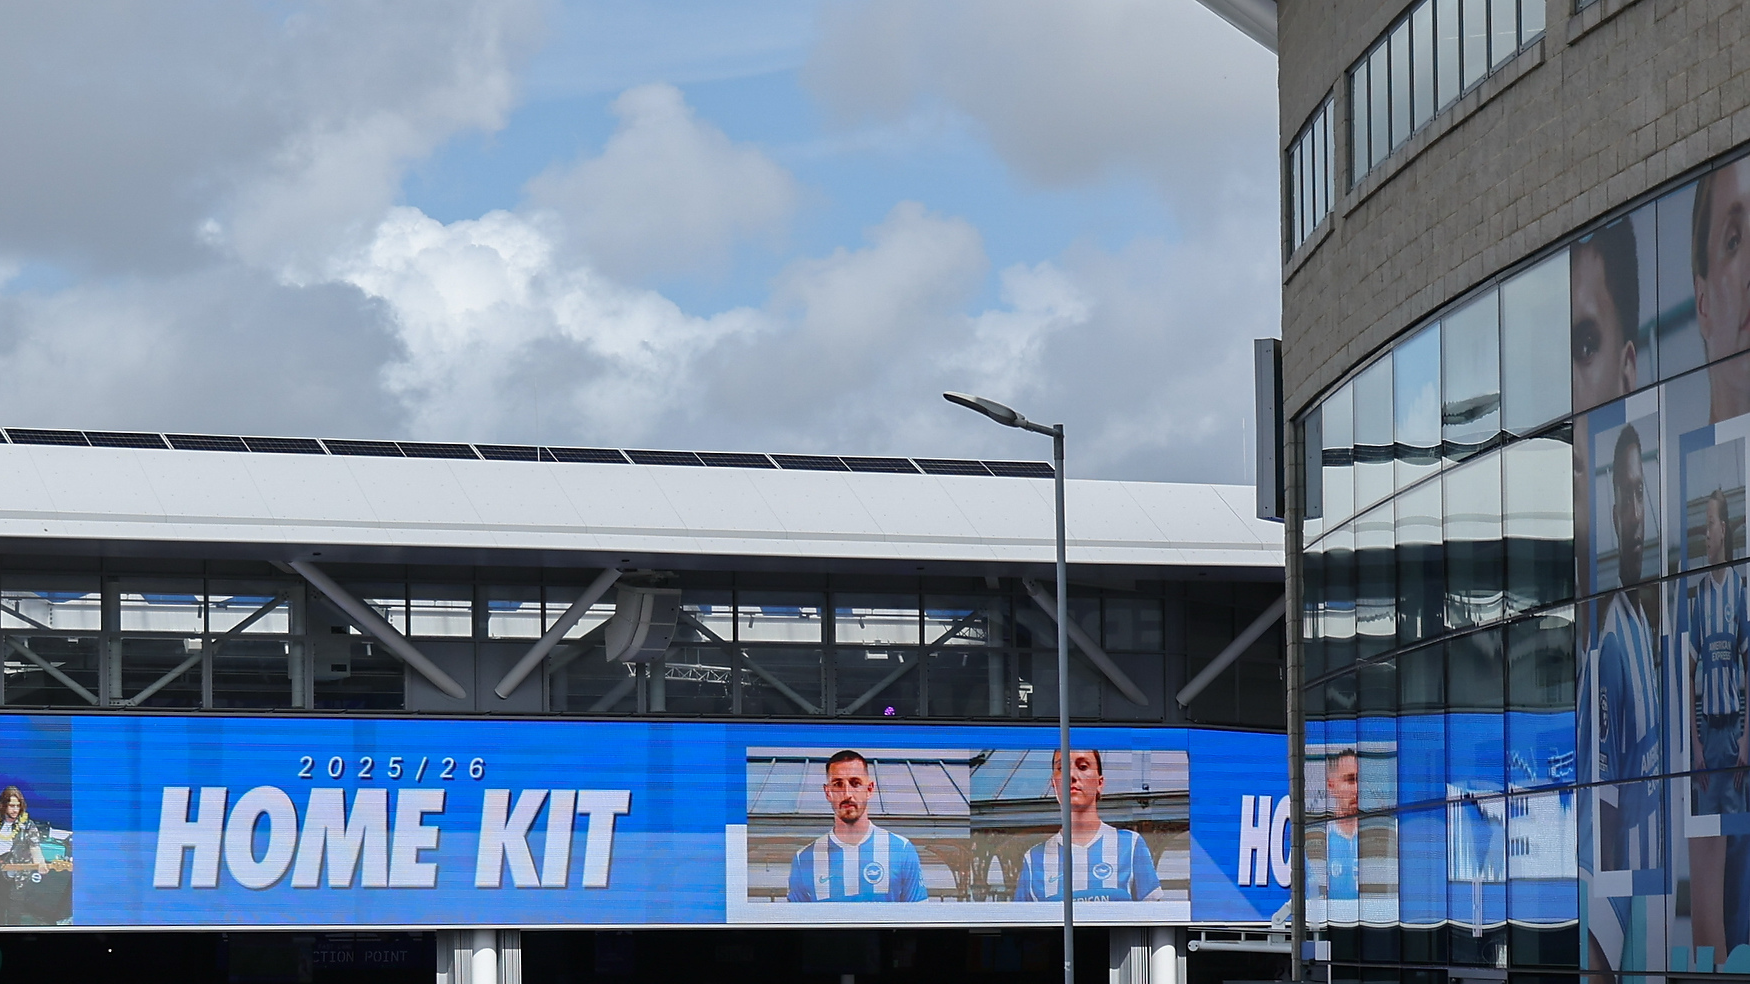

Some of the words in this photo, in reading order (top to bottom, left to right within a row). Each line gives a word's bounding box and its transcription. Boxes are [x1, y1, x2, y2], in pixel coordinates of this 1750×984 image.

[298, 755, 486, 782] 2025/26
[153, 785, 446, 890] HOME
[474, 788, 631, 889] KIT
[365, 950, 408, 963] POINT
